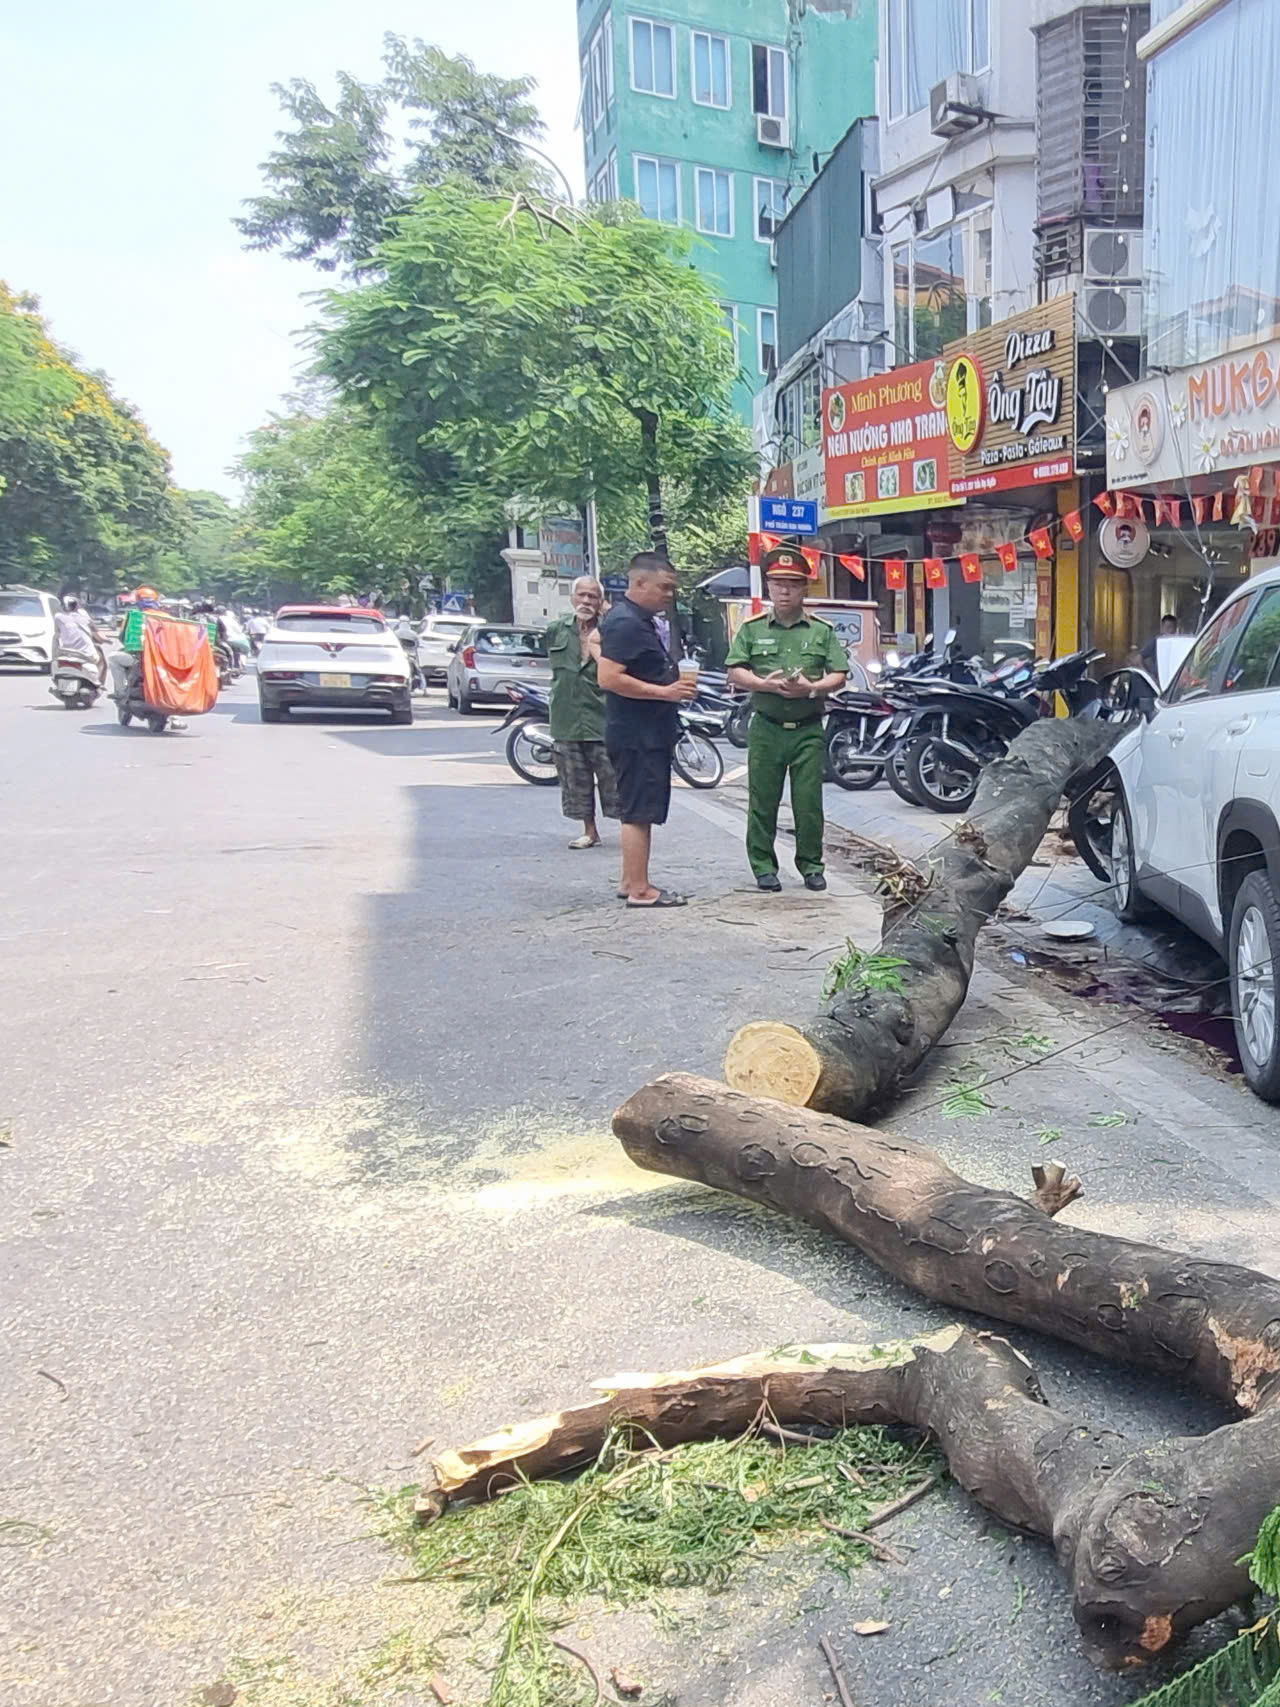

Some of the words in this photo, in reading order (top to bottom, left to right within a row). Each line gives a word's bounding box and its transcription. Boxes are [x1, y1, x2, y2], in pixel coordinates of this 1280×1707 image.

[1005, 330, 1053, 370] Pizza
[851, 388, 877, 414] Minh
[879, 377, 923, 407] Phương
[987, 370, 1022, 431] Ông
[1021, 369, 1060, 437] Tây
[827, 432, 849, 459] NEM
[849, 420, 889, 453] NƯỚNG
[890, 417, 914, 447] NHA
[915, 410, 950, 441] TRAN
[791, 505, 805, 518] 237
